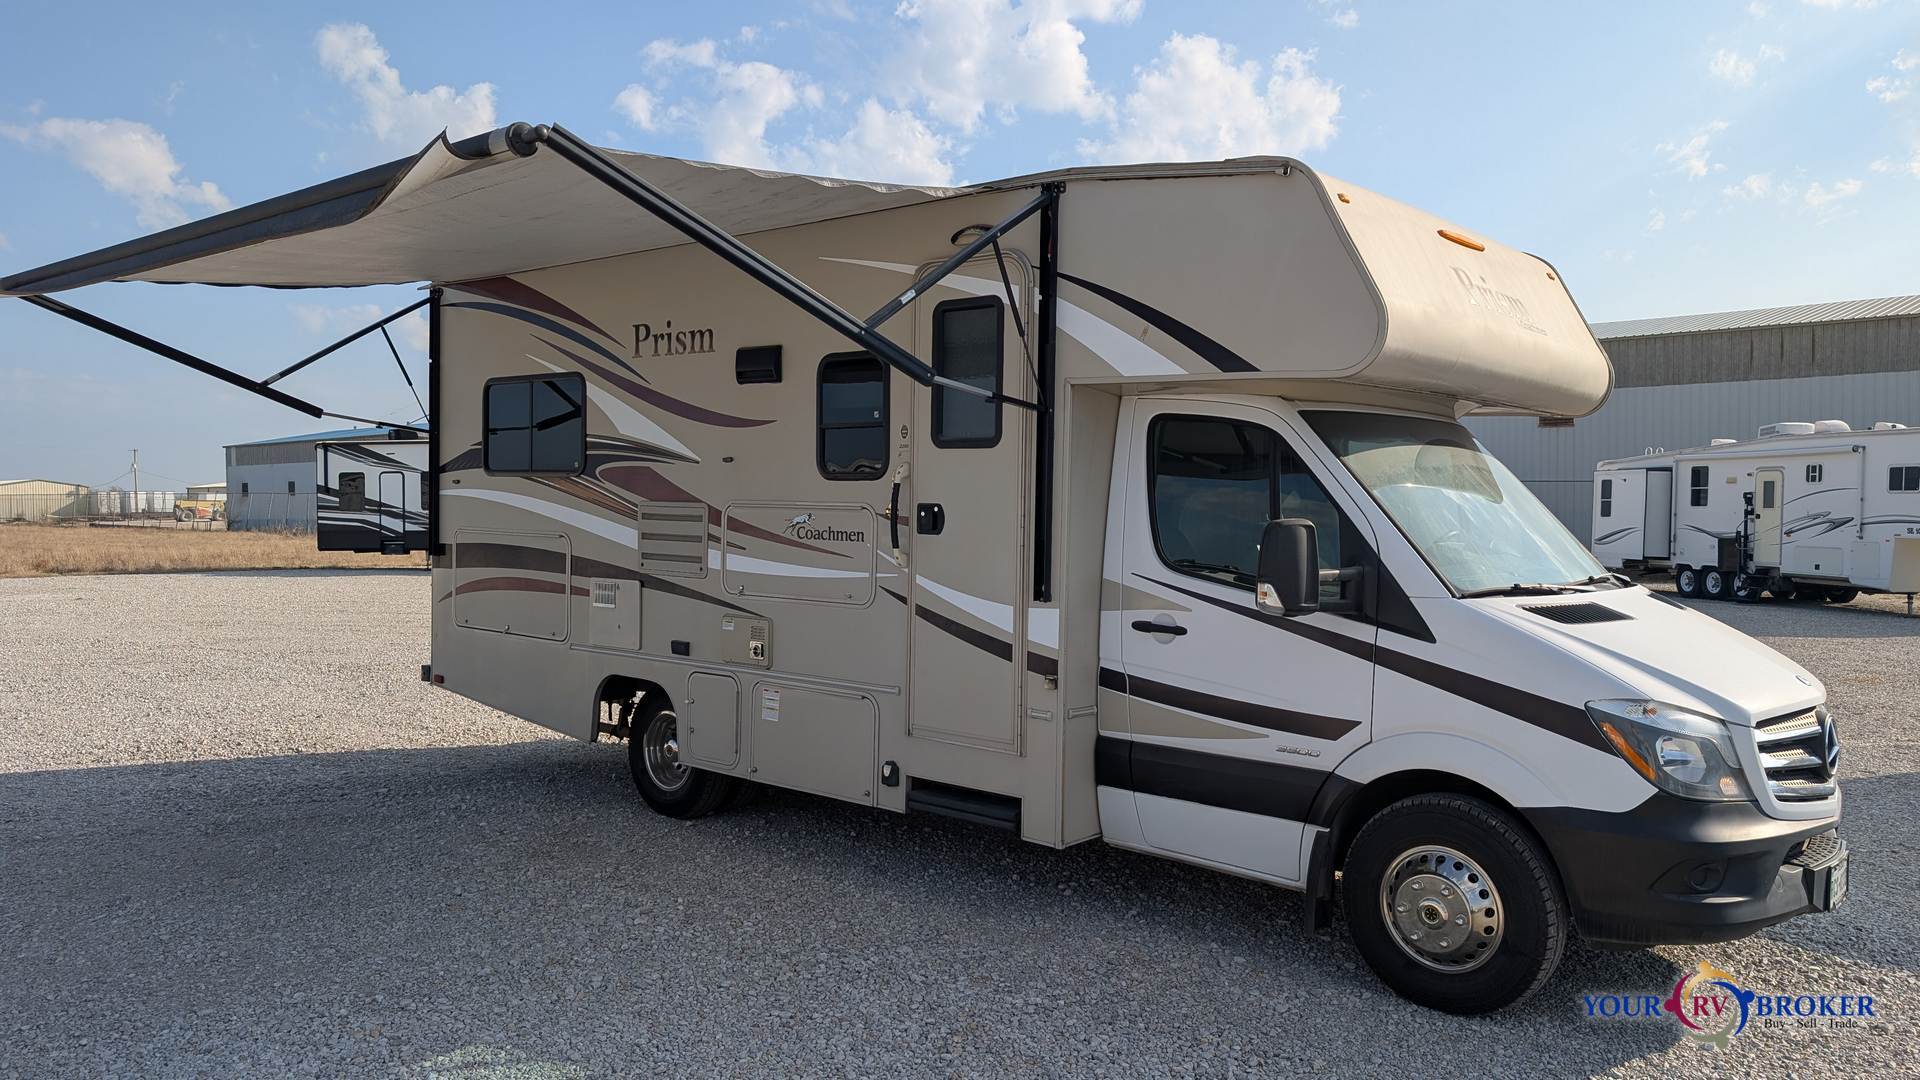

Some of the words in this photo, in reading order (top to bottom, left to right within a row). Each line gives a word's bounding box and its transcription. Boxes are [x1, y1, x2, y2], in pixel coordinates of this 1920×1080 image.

[1449, 265, 1531, 326] Prism
[632, 320, 716, 359] Prism
[796, 526, 865, 542] Coachmen
